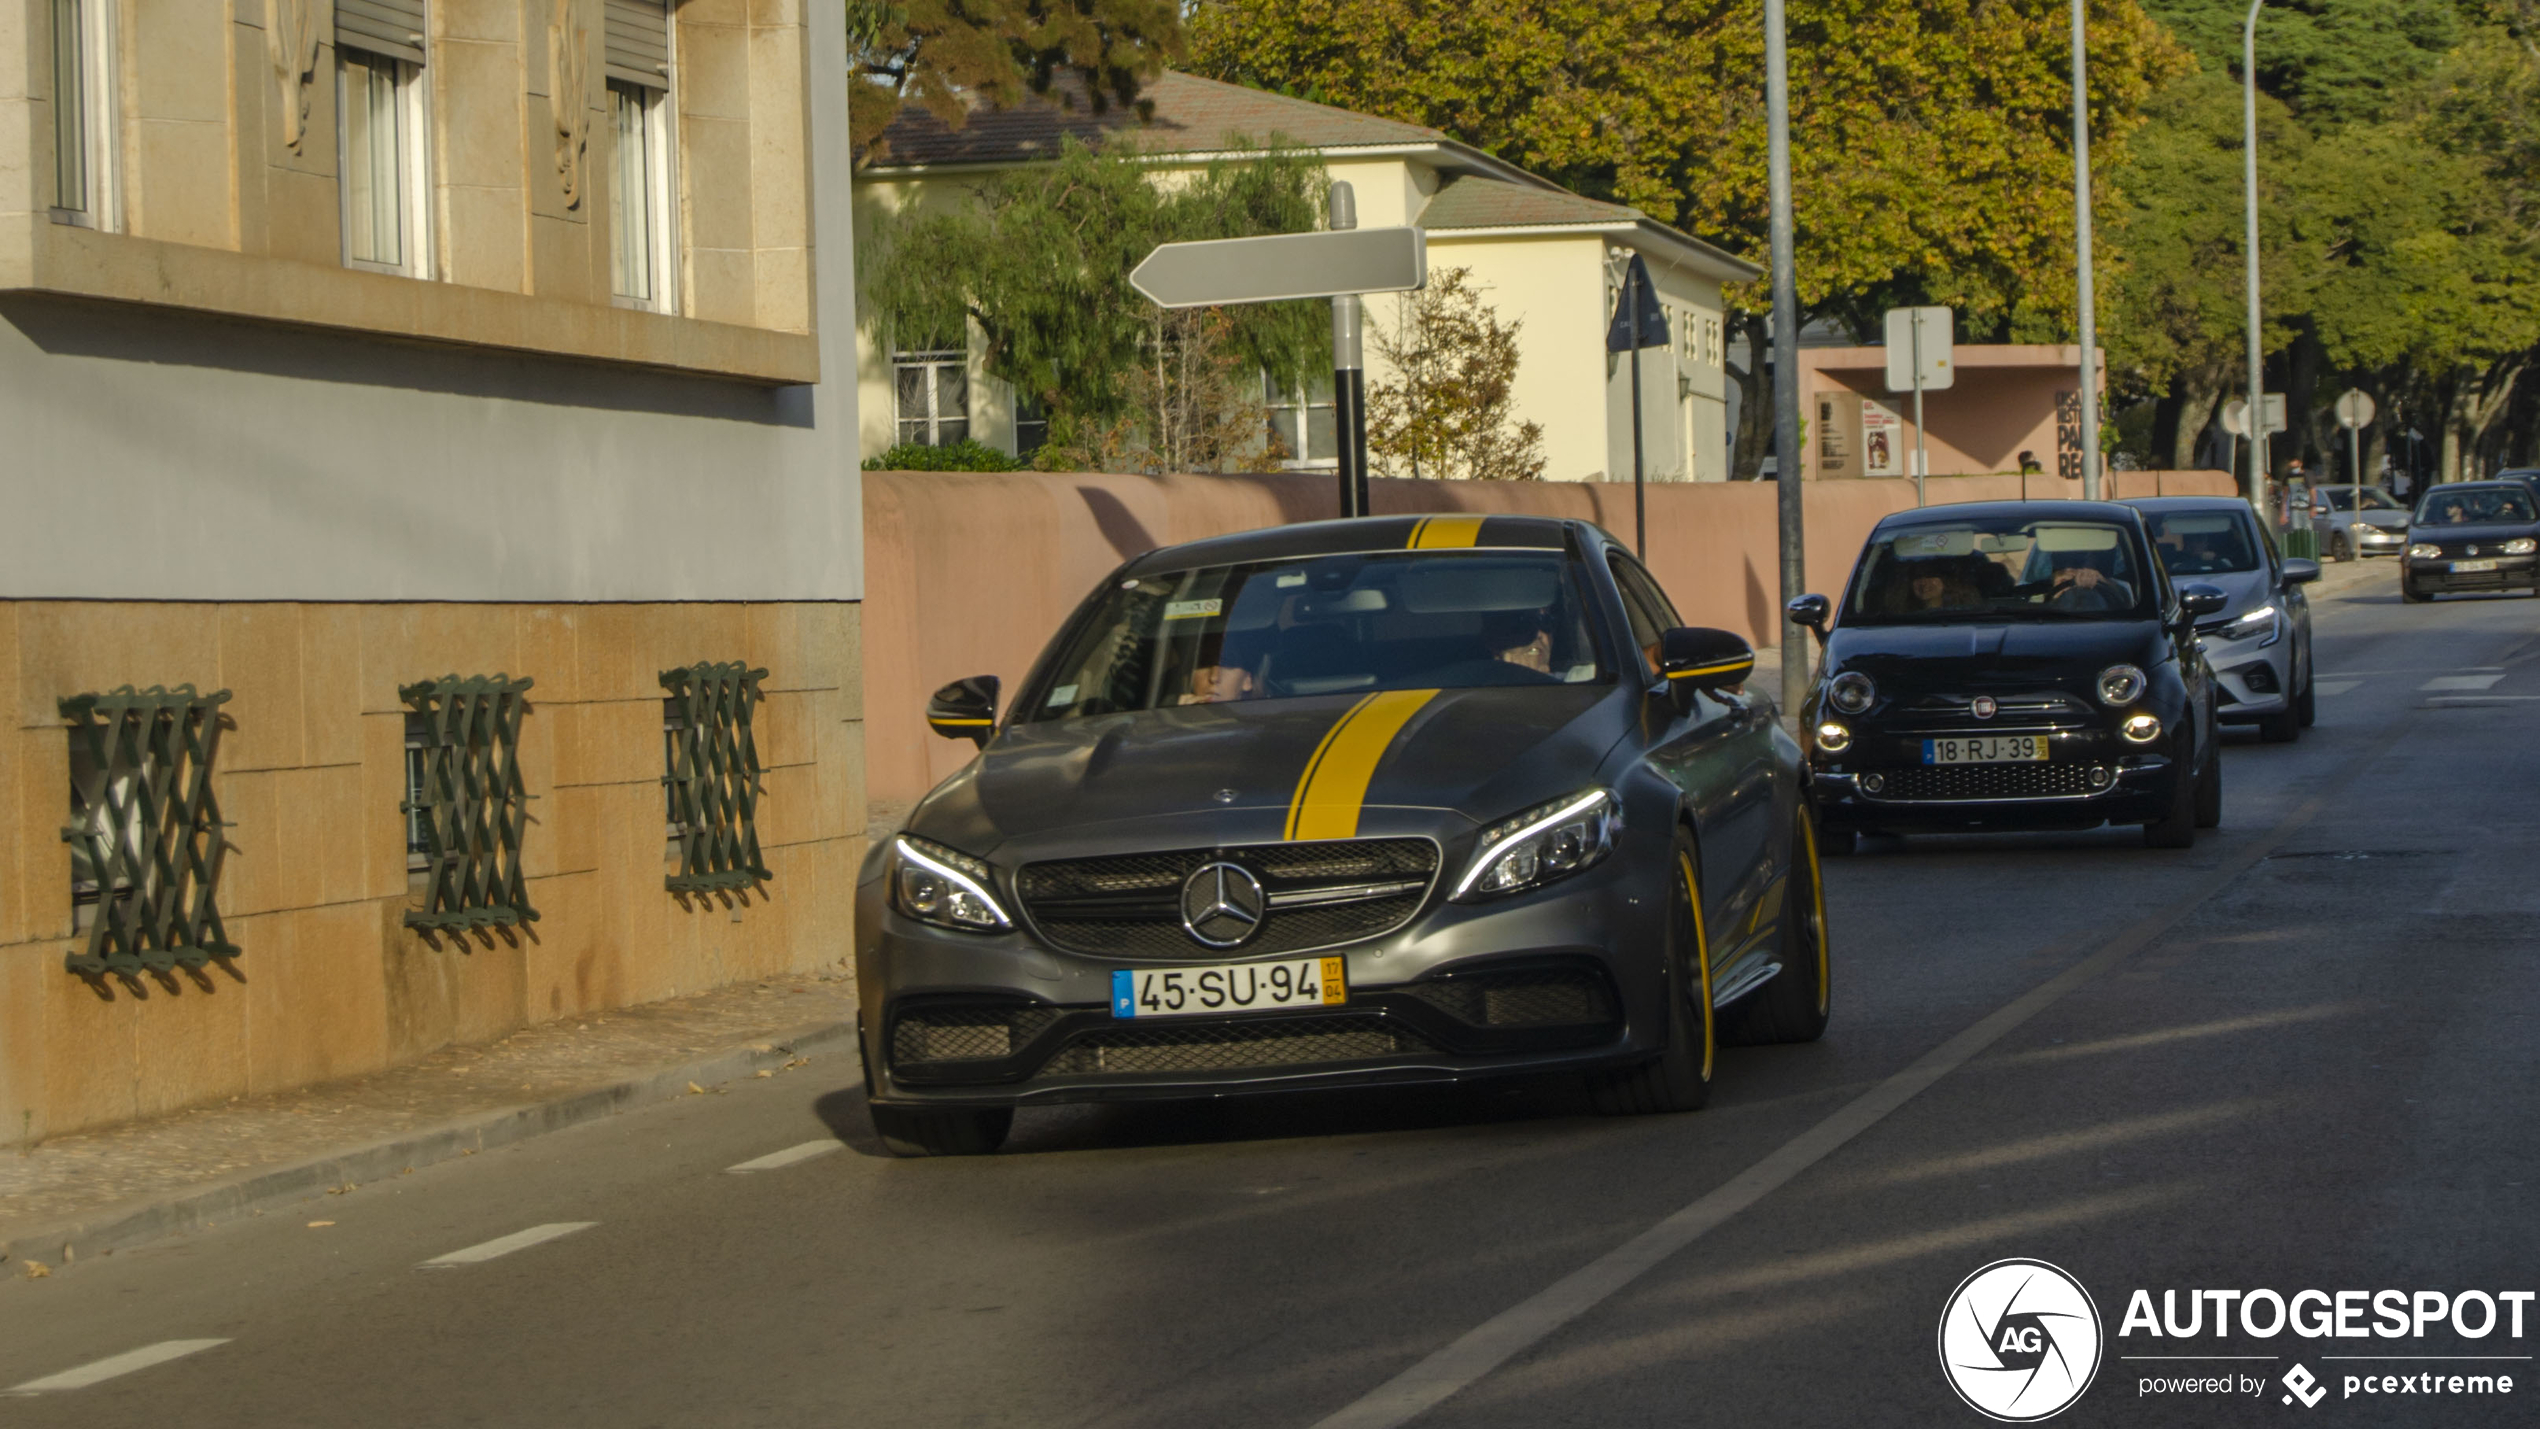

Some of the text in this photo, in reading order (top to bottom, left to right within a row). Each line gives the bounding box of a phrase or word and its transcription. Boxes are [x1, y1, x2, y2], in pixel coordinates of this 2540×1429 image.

[1326, 962, 1340, 975] 17
[1325, 986, 1341, 998] 04
[1120, 998, 1129, 1009] P
